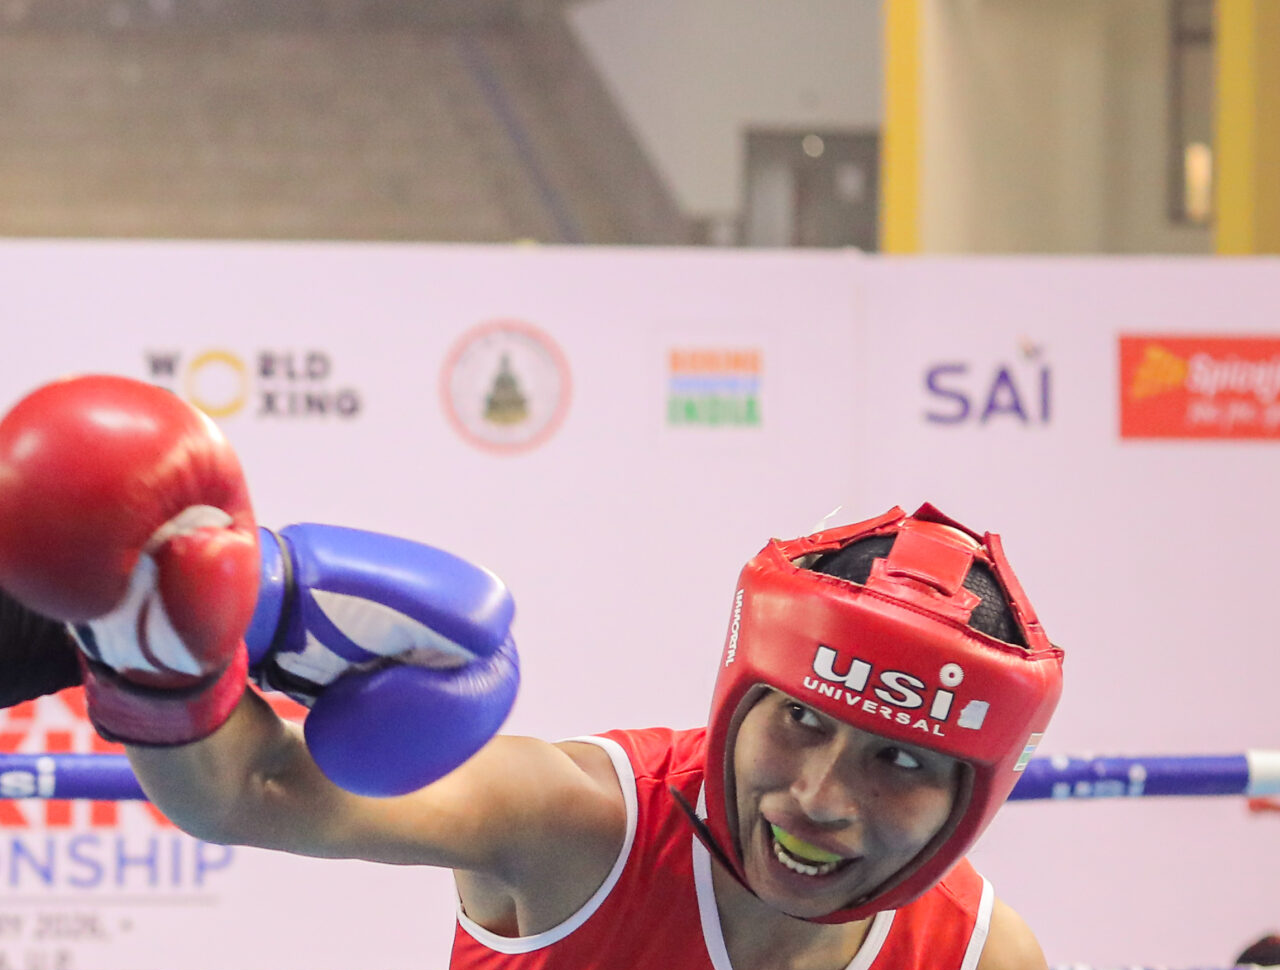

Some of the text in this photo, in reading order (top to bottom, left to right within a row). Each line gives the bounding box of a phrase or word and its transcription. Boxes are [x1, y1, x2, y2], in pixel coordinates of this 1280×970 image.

[926, 364, 1048, 423] SAI
[803, 676, 946, 737] UNIVERSAL
[812, 645, 965, 723] usi
